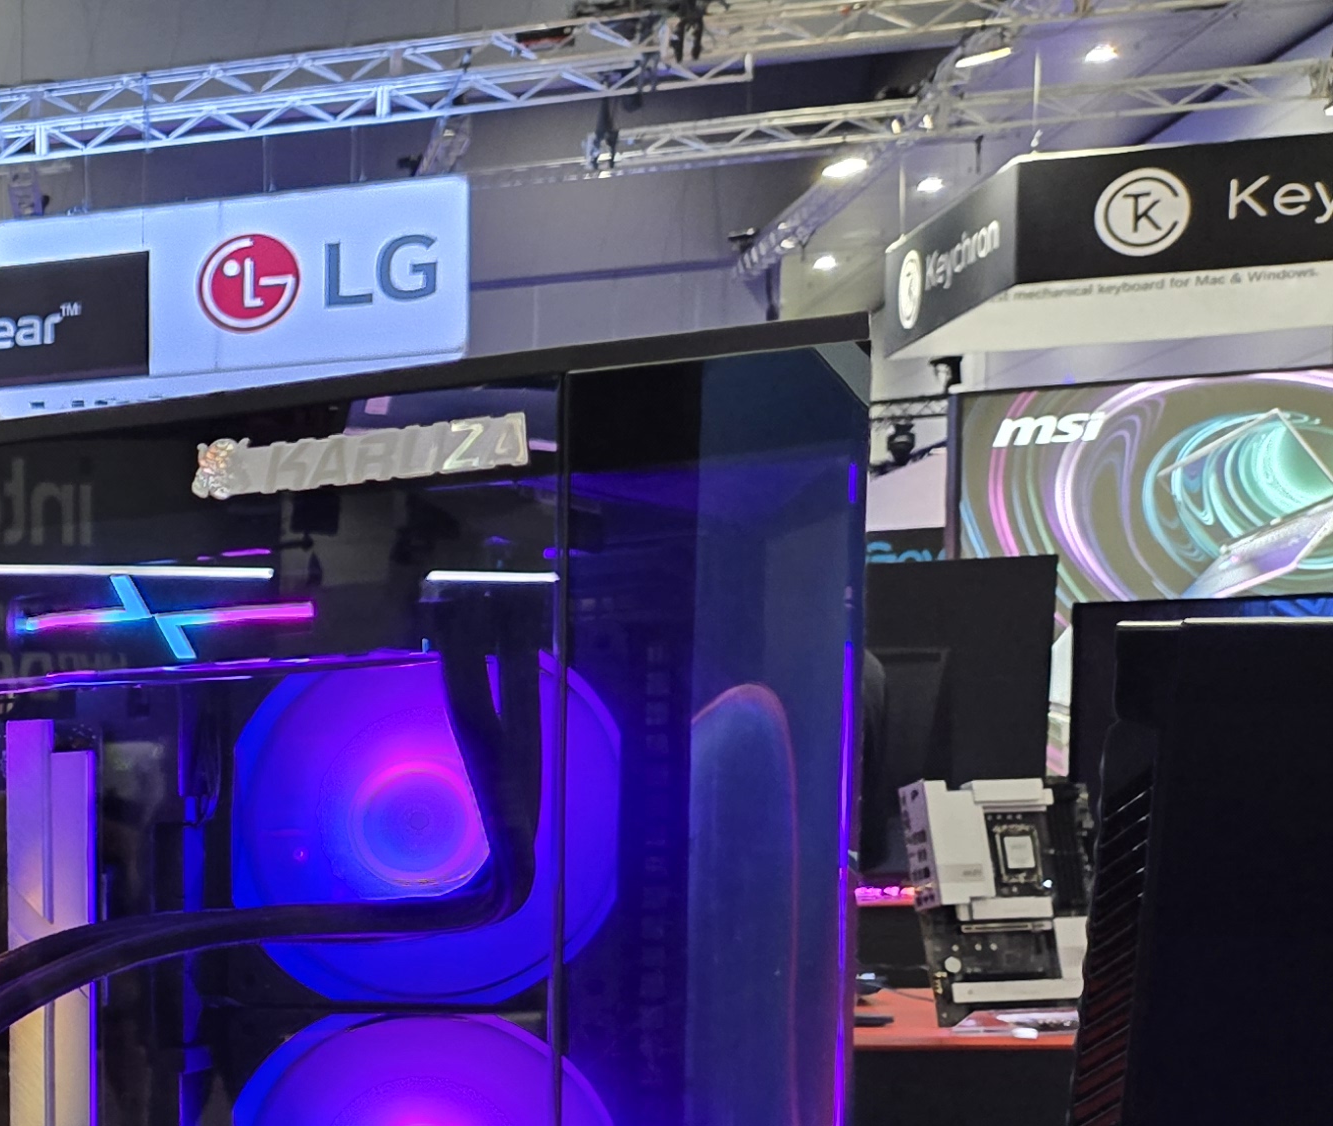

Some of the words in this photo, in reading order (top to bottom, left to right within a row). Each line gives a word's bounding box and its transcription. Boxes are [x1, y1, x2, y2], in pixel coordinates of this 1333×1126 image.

[325, 234, 438, 308] LG
[924, 220, 1000, 291] Keychron
[1098, 278, 1165, 297] keyboard
[1170, 277, 1191, 290] for
[1195, 274, 1226, 288] Mac
[263, 415, 524, 492] KARUZA
[992, 411, 1105, 448] msi
